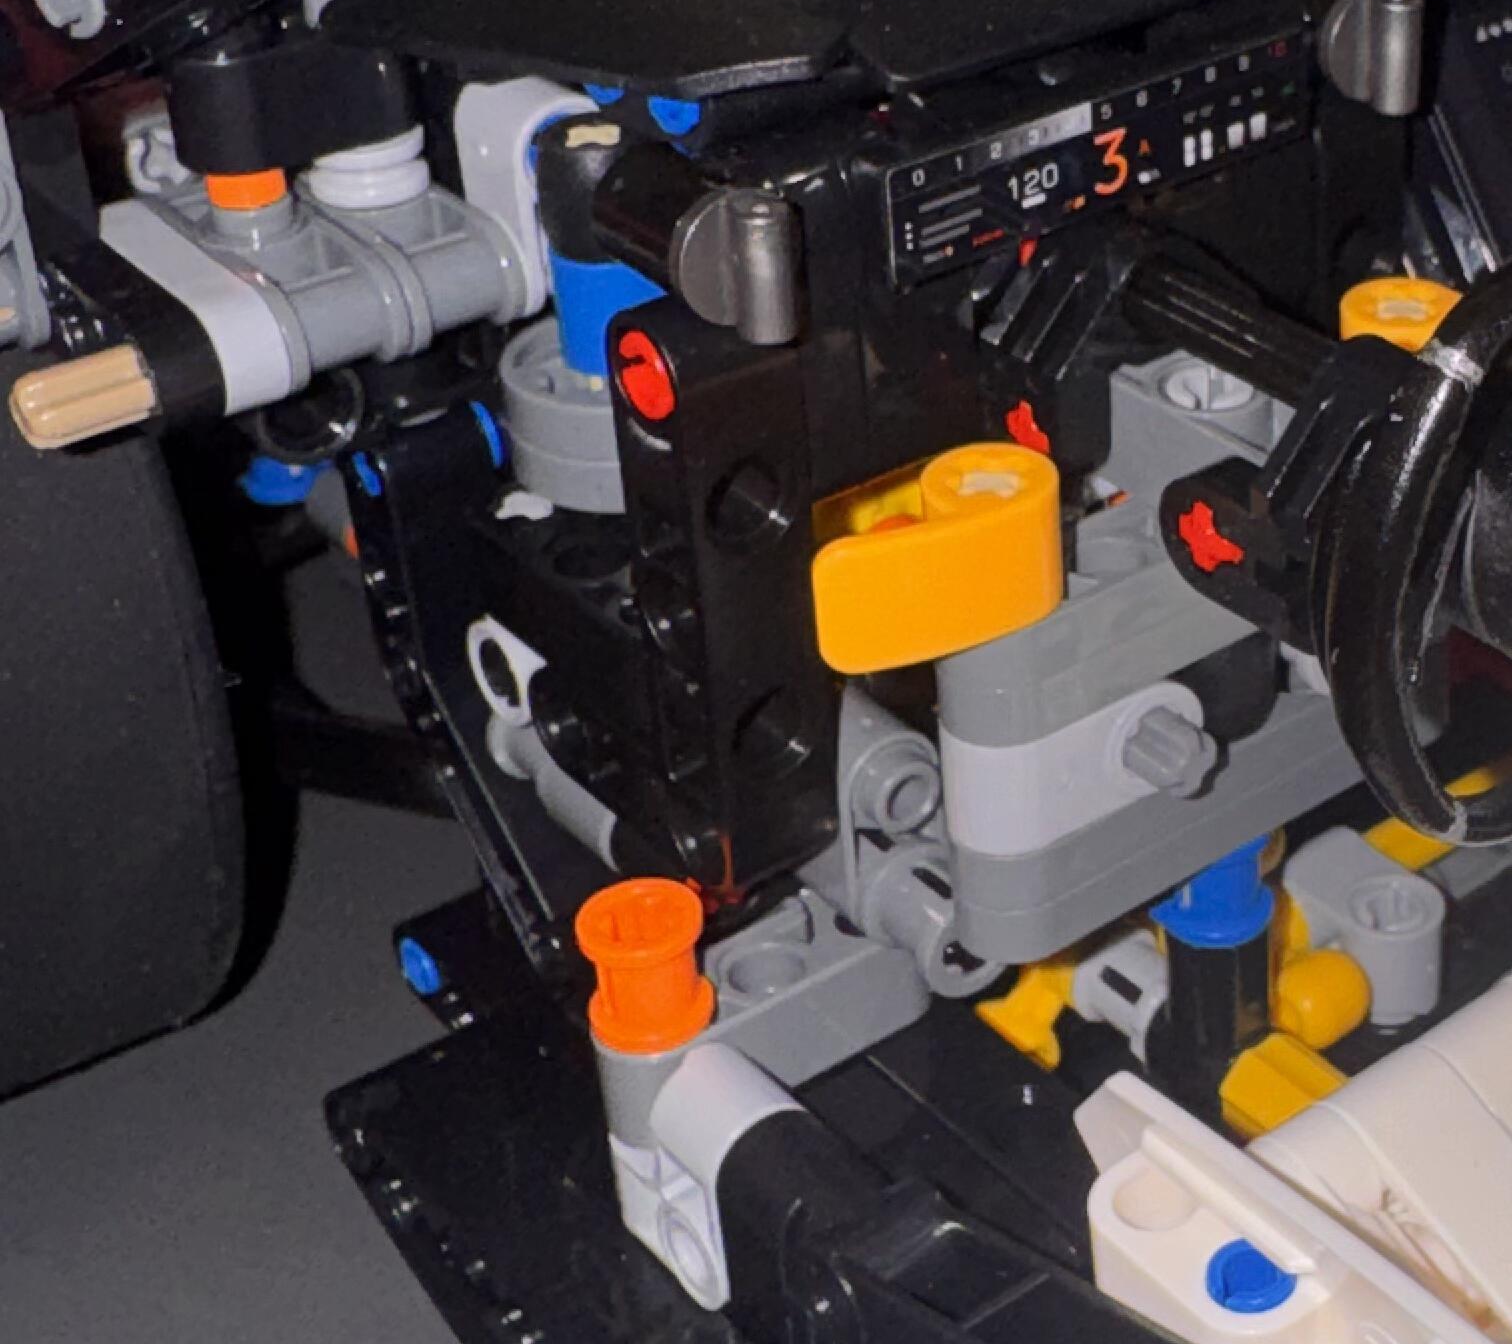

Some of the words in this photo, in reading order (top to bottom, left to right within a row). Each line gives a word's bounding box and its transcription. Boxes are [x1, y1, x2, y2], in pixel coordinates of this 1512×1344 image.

[911, 168, 926, 187] 0
[955, 155, 964, 172] 1
[990, 141, 1002, 160] 2
[1007, 162, 1060, 201] 120
[1093, 126, 1129, 196] 3
